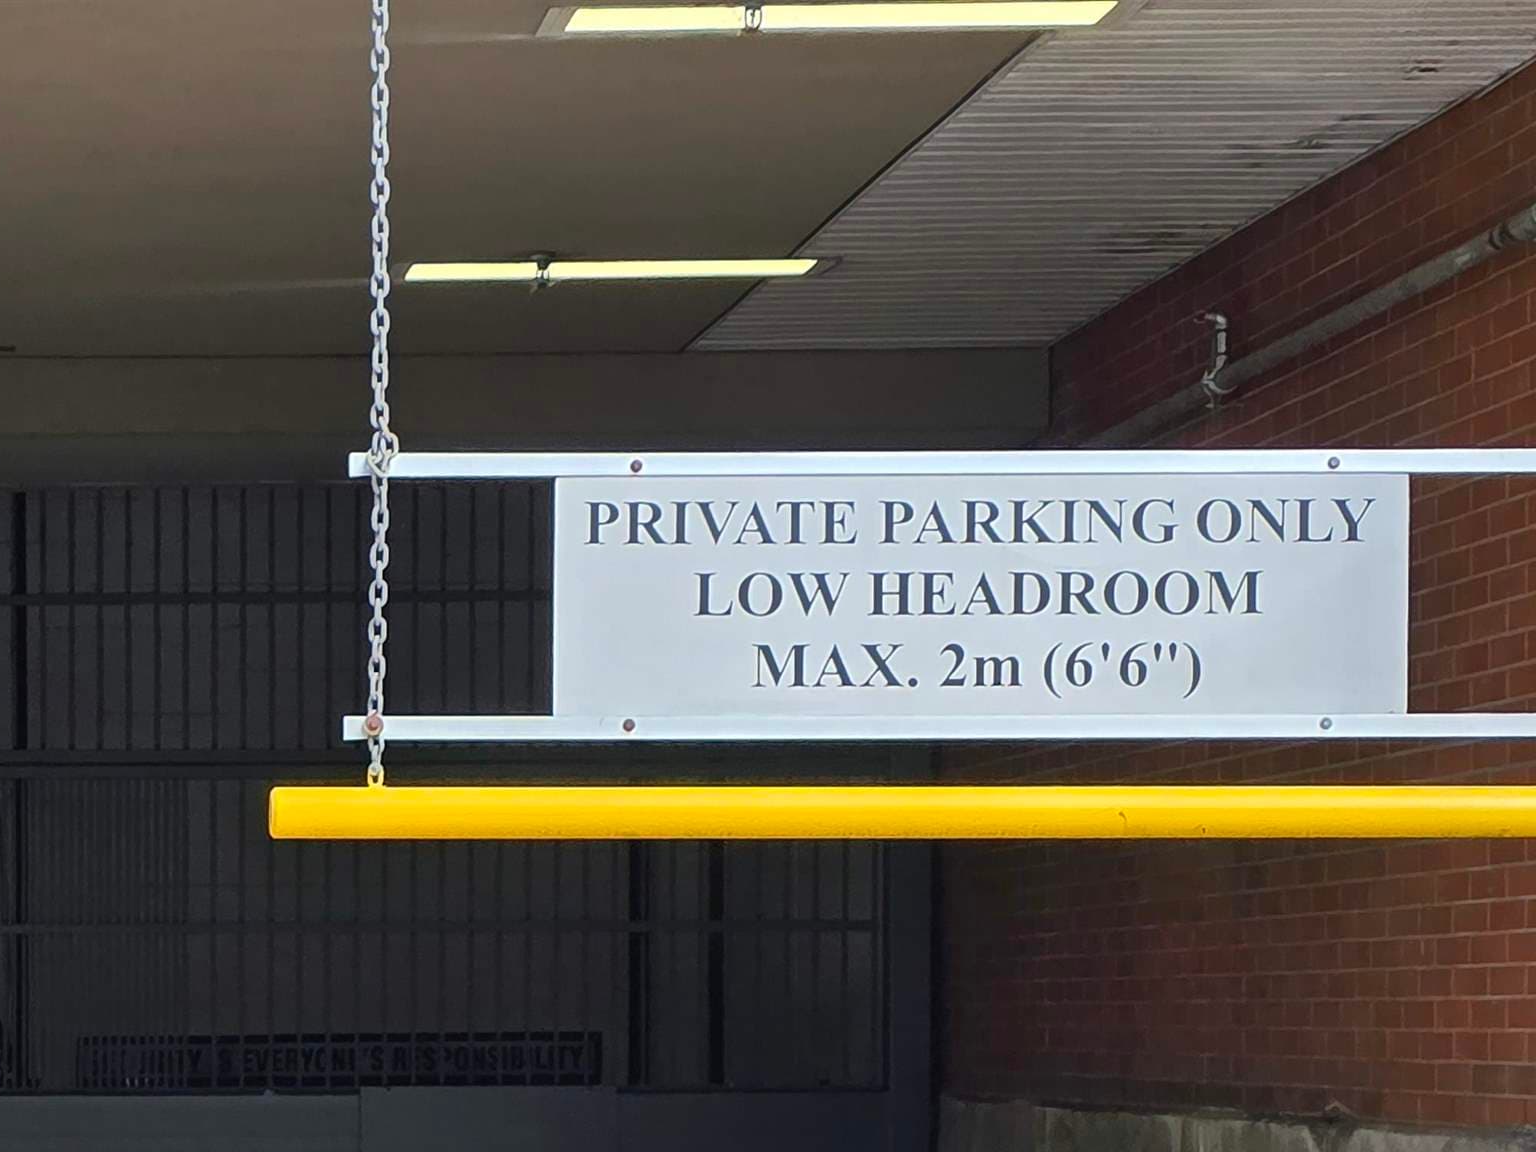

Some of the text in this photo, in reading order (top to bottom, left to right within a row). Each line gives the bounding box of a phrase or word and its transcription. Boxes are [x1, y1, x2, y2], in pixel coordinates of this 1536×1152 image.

[584, 497, 1378, 546] PRIVATE PARKING ONLY
[694, 569, 1264, 617] LOW HEADROOM
[752, 642, 919, 688] MAX.
[940, 642, 1022, 688] 2m
[393, 1046, 583, 1071] RESPONSIBLITY
